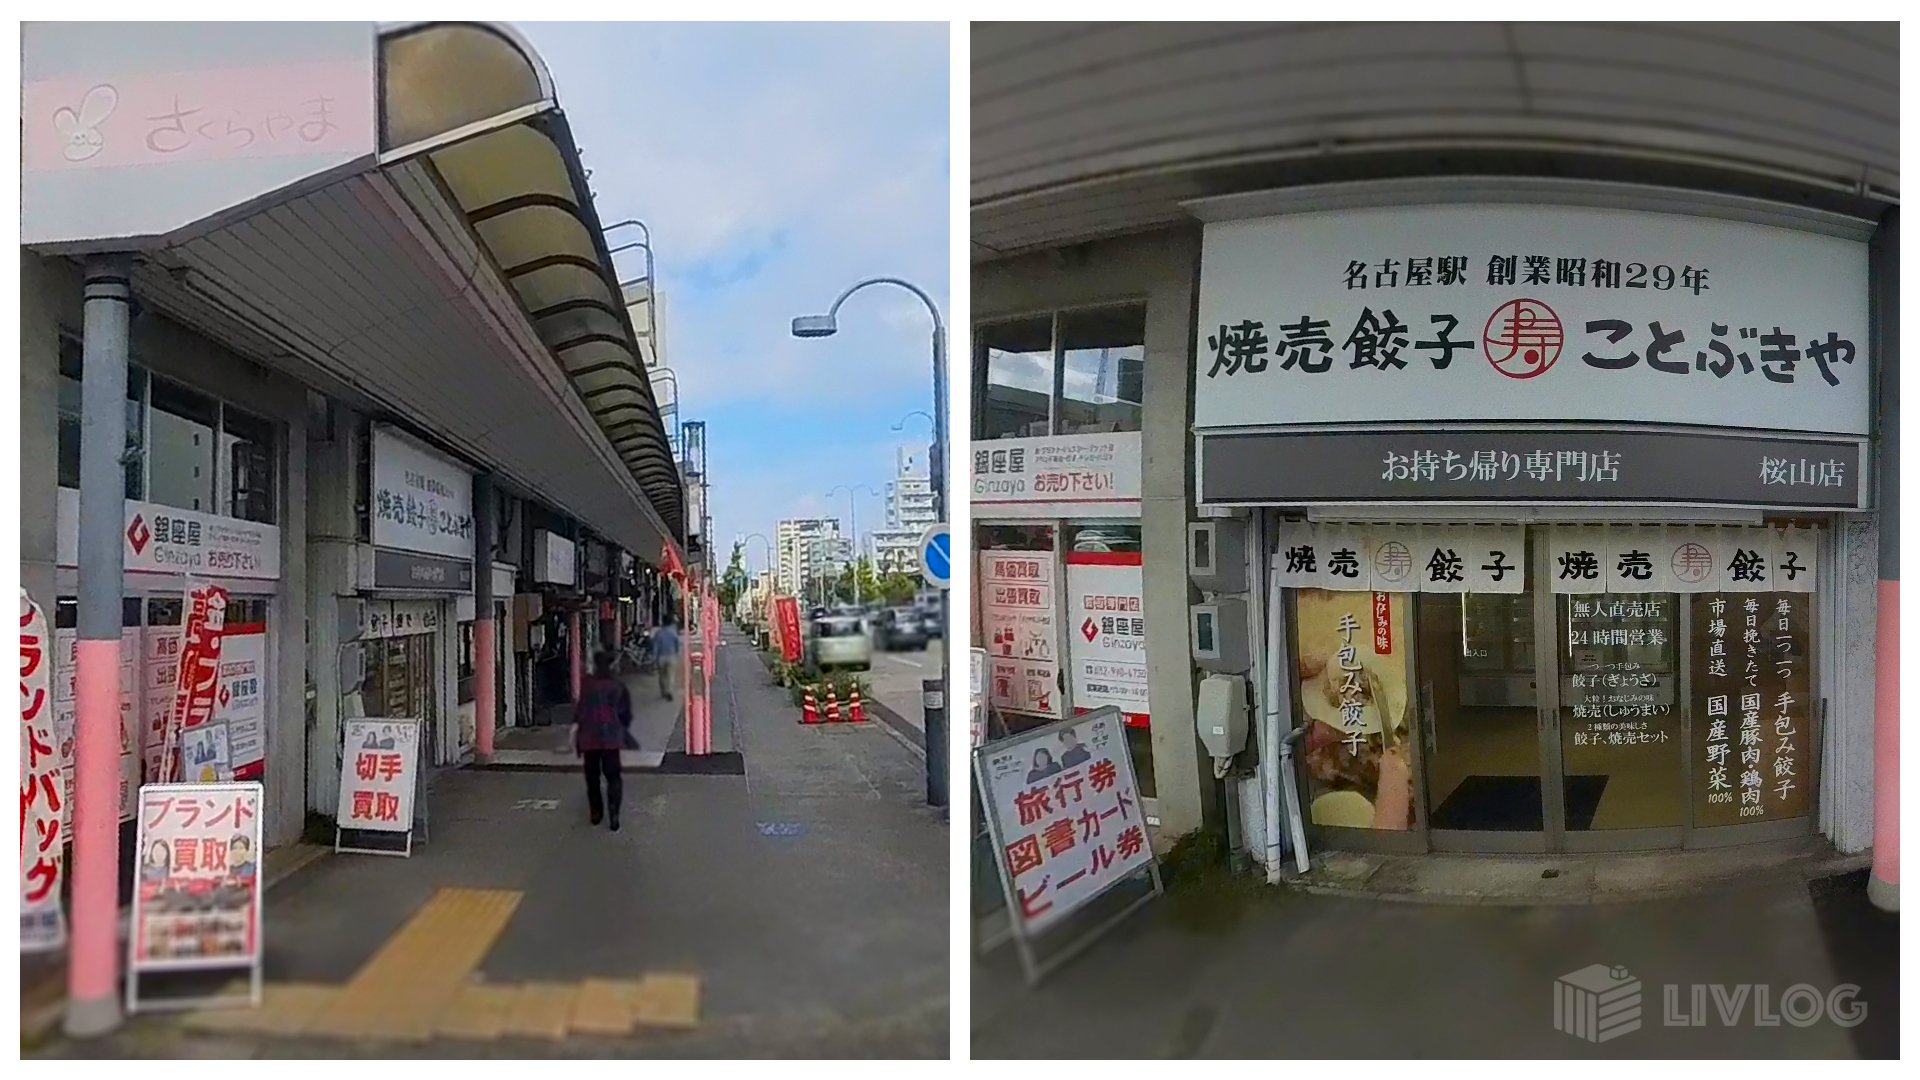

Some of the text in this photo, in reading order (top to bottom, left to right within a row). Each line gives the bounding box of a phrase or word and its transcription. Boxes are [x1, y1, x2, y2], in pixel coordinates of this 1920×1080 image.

[145, 94, 343, 152] さくらやま
[1342, 254, 1711, 295] 名古屋駅 創業昭和29年
[1207, 306, 1476, 378] 焼売餃子
[1581, 319, 1857, 387] ことぶきや
[974, 448, 1025, 474] 銀座屋
[1381, 449, 1845, 488] お持ち帰り専門店 桜山店
[1285, 544, 1361, 578] 焼売
[1425, 547, 1515, 582] 餃子
[1558, 549, 1653, 580] 焼売
[1727, 548, 1806, 582] 餃子
[1573, 600, 1661, 618] 無人直売店
[1336, 611, 1367, 757] 手包み餃子
[1706, 598, 1733, 804] 市場直送 国産野菜 100%
[1773, 599, 1797, 801] 毎日一つ一つ 手包み餃子
[1739, 598, 1764, 817] 毎日挽きたて 国産豚肉・鶏肉 100%
[355, 752, 402, 782] 切手
[351, 791, 399, 821] 買取
[1014, 757, 1117, 827] 旅行券
[145, 797, 255, 829] ブランド
[1005, 787, 1134, 877] 図書カード
[172, 838, 228, 872] 買取
[1016, 825, 1144, 919] ビール券
